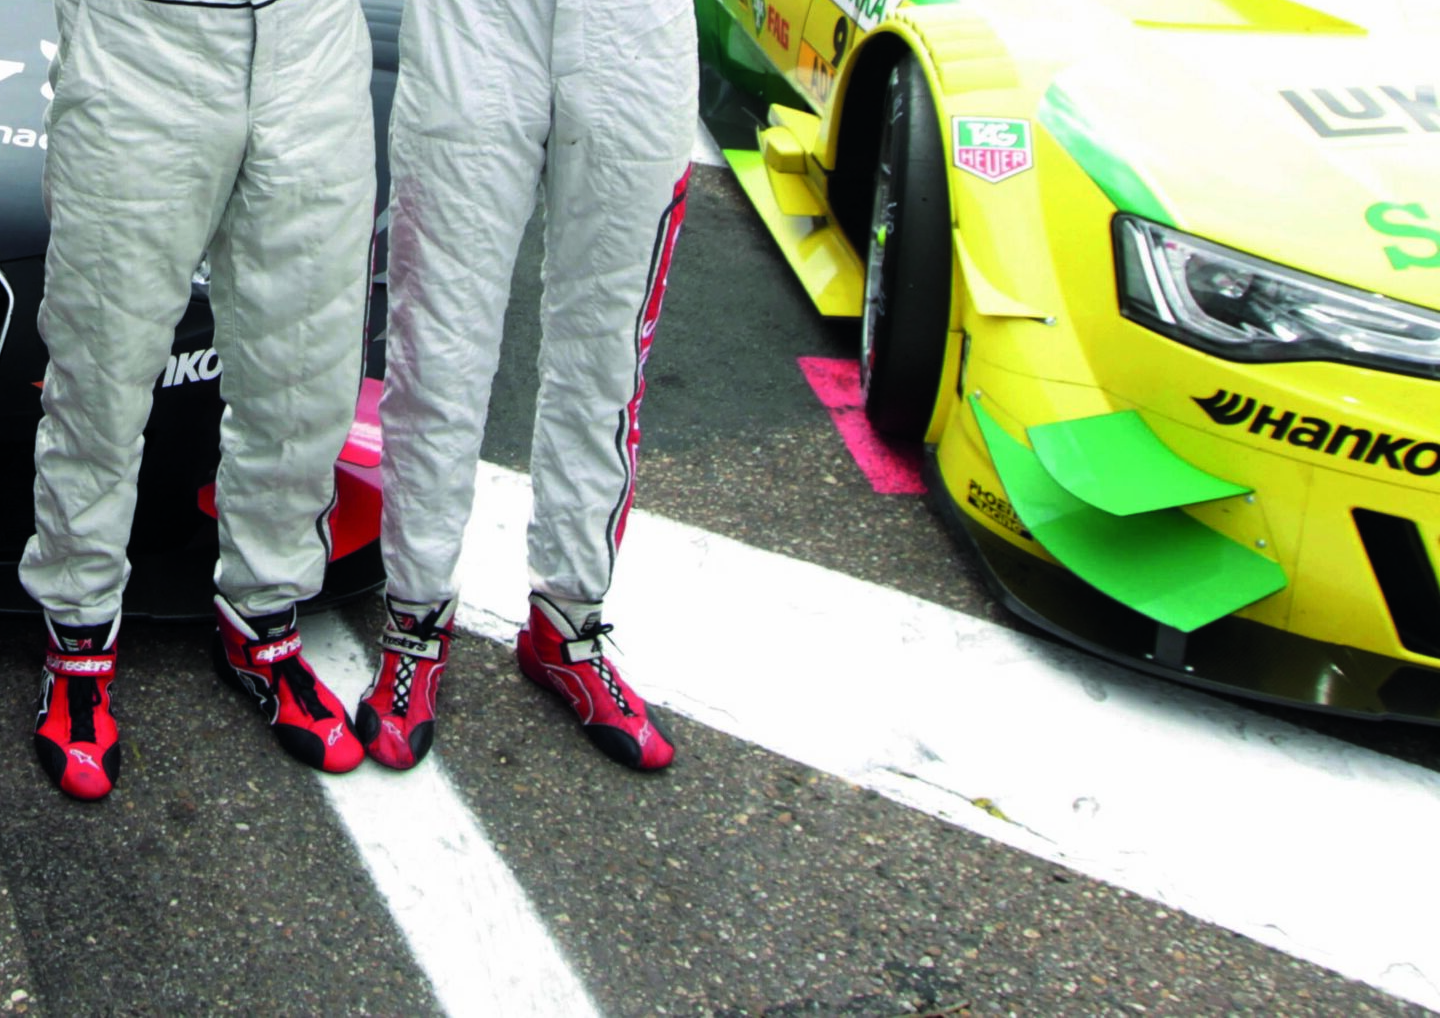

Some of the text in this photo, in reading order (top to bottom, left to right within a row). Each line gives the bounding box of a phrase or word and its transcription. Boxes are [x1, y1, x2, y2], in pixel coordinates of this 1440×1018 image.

[768, 5, 790, 51] FAG
[831, 16, 849, 69] 9
[966, 123, 1019, 147] TAG
[959, 150, 1026, 177] HEUER
